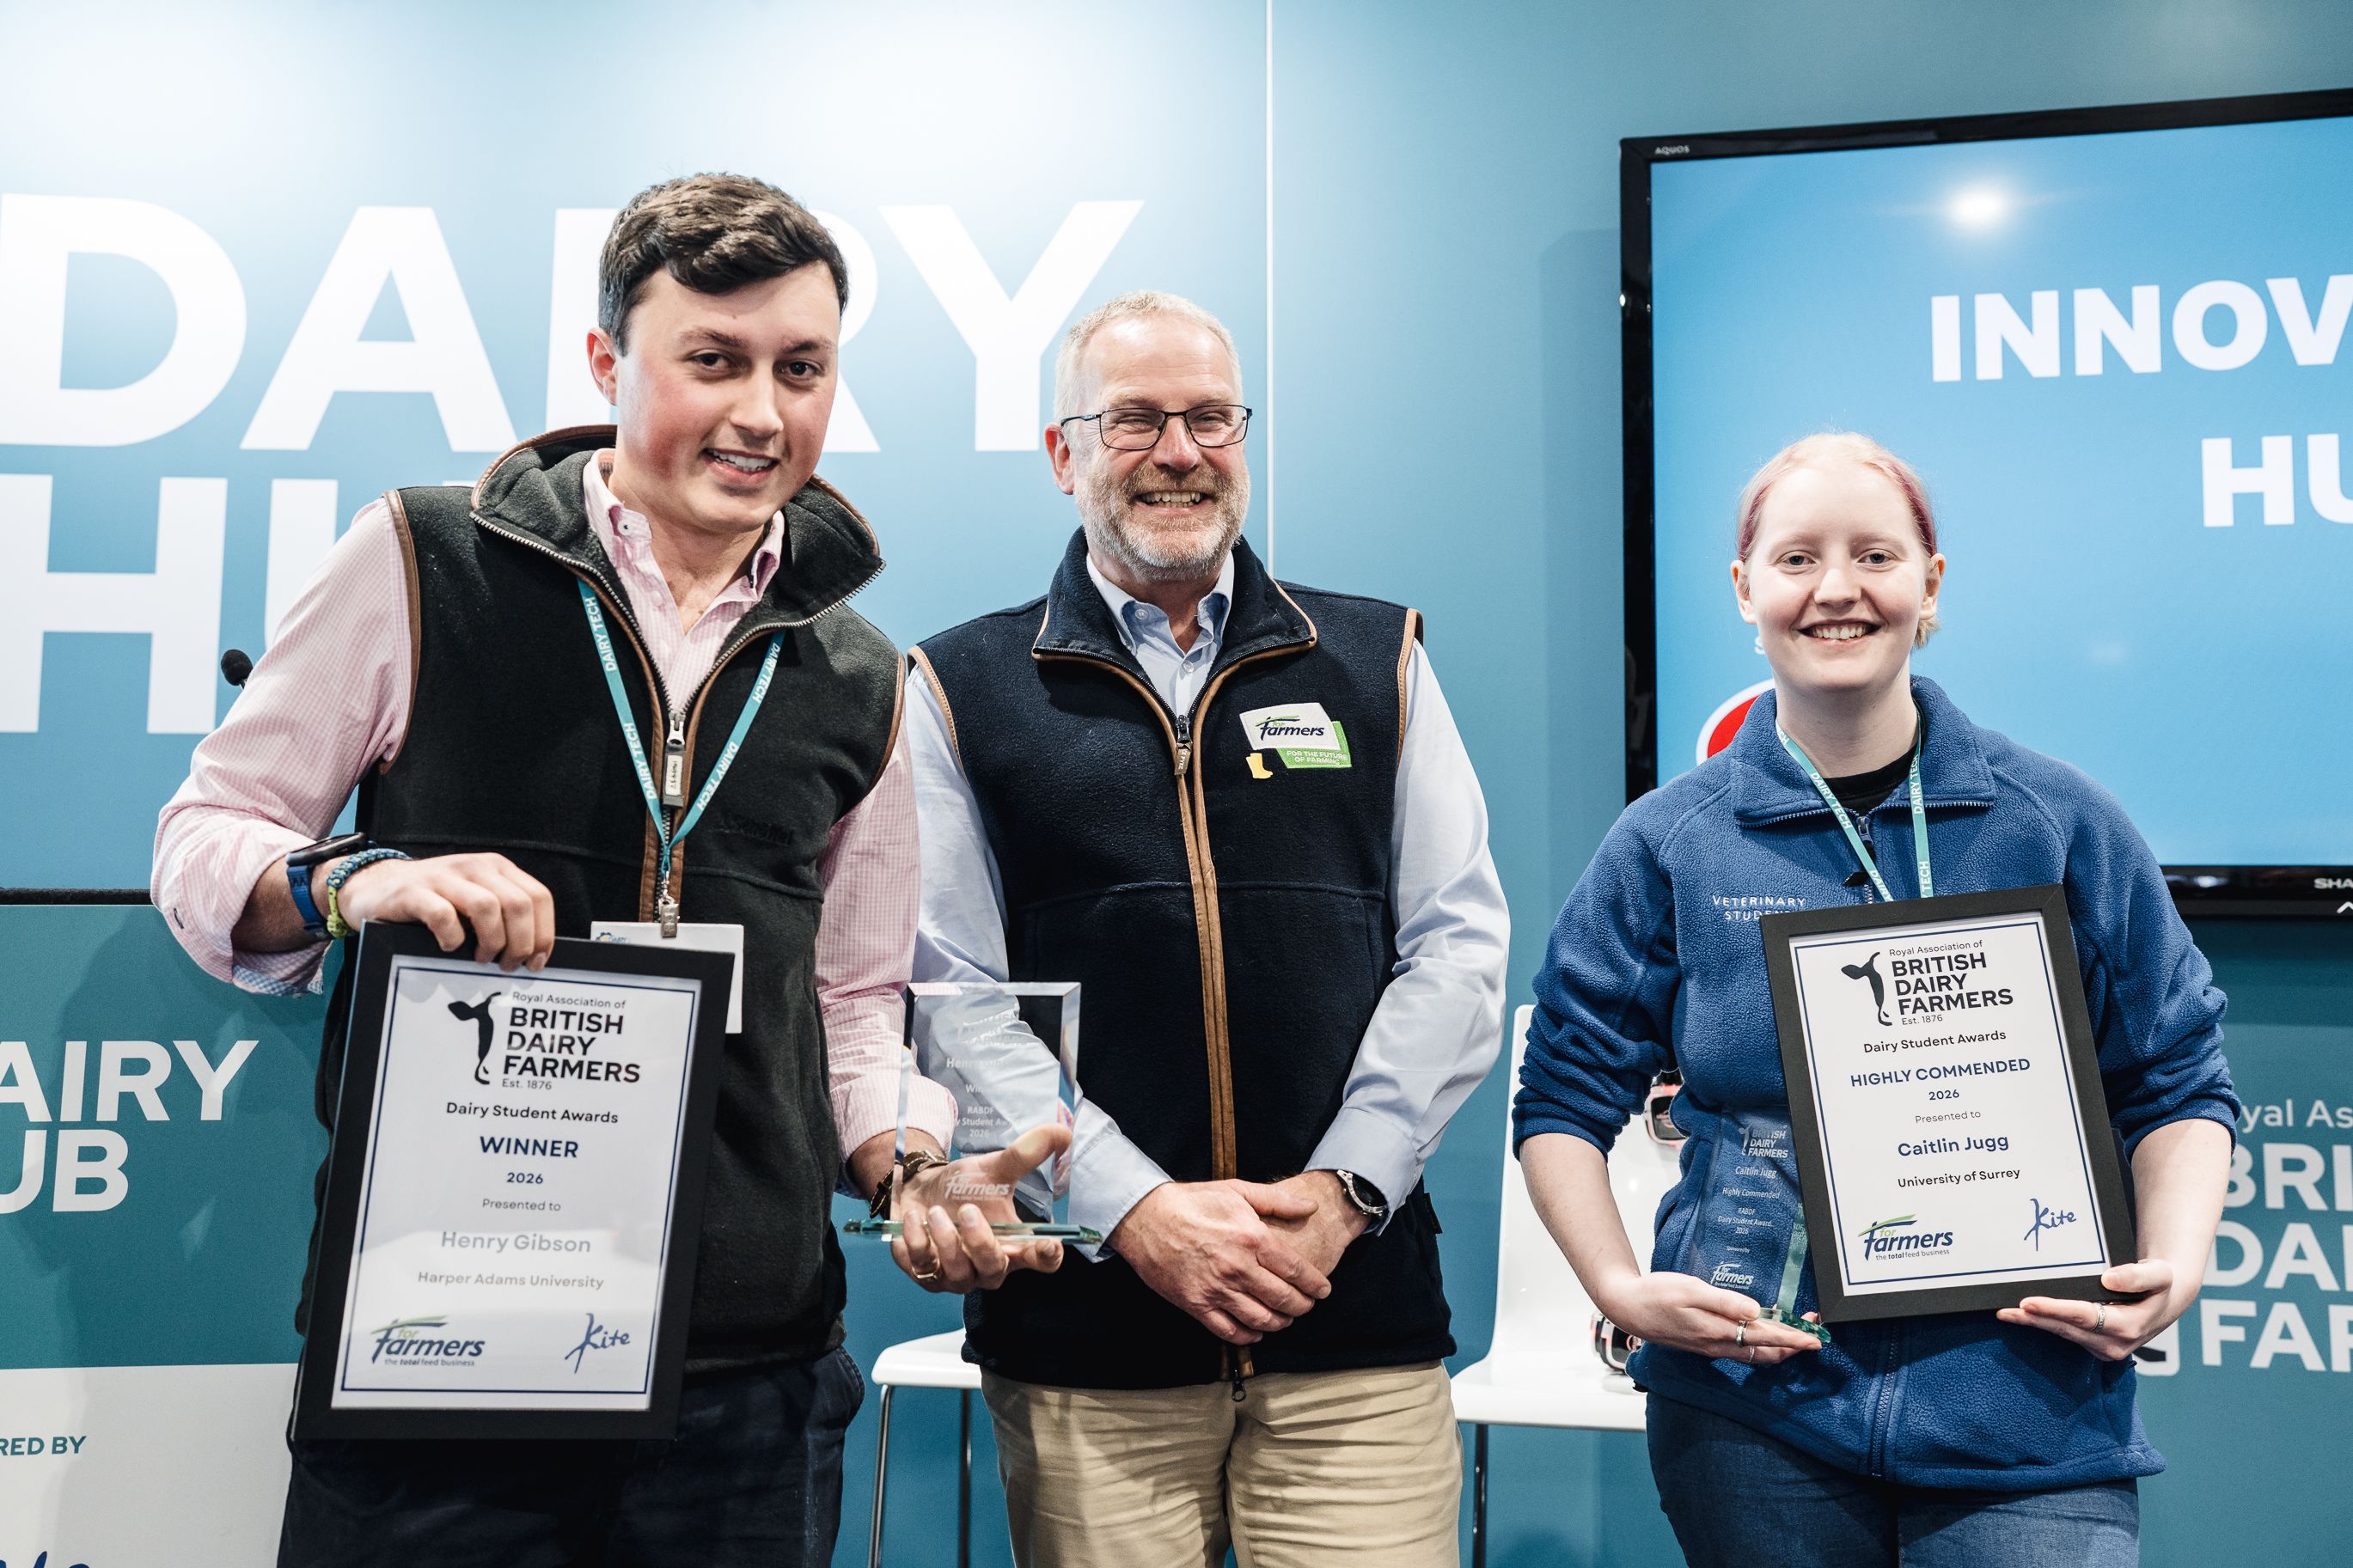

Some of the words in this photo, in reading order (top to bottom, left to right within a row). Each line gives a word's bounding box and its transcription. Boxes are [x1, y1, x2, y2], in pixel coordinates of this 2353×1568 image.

[1654, 145, 1690, 156] AQUOS
[0, 193, 1145, 453] DAIY
[1930, 274, 2353, 383] INNOV
[585, 596, 603, 631] TECH
[596, 631, 618, 672] DAIRY
[761, 642, 781, 677] DAIRY
[752, 673, 771, 704] TECH
[624, 723, 644, 758] TECH
[1777, 730, 1789, 745] CH
[716, 741, 739, 778] DAIRY
[1306, 758, 1340, 766] FARMING
[1909, 754, 1919, 778] TECH
[636, 759, 657, 800] DAIRY
[696, 778, 720, 811] TECH
[1810, 772, 1835, 801] DAIRY
[1830, 801, 1853, 829] TECH
[1911, 779, 1923, 815] DAIRY
[1868, 869, 1894, 902] DAIRY
[1919, 860, 1930, 893] TECH
[1712, 894, 1806, 907] VETERINARY
[1724, 910, 1796, 921] STUD
[1889, 947, 1916, 958] Royal
[1916, 941, 1971, 955] Association
[1973, 939, 1983, 949] of
[1892, 951, 1988, 978] BRITISH
[1895, 973, 1968, 997] DAIRY
[512, 991, 544, 1004] Royal
[546, 994, 611, 1009] Association
[614, 1000, 626, 1010] of
[1898, 988, 2014, 1016] FARMERS
[510, 1006, 624, 1035] BRITISH
[1902, 1017, 1920, 1026] Est.
[1922, 1014, 1943, 1024] 1876
[507, 1031, 597, 1056] DAIRY
[1863, 1040, 1898, 1053] Dairy
[1900, 1035, 1955, 1050] Student
[1958, 1030, 2007, 1045] Awards
[503, 1055, 641, 1083] FARMERS
[1850, 1069, 1911, 1088] HIGHLY
[1915, 1058, 2031, 1081] COMMENDED
[0, 1040, 260, 1122] AIRY
[502, 1077, 523, 1089] Est.
[527, 1079, 553, 1090] 1876
[1928, 1089, 1960, 1101] 2026
[446, 1101, 490, 1118] Dairy
[492, 1105, 557, 1120] Student
[559, 1109, 619, 1124] Awards
[962, 1117, 994, 1126] Student
[967, 1106, 995, 1114] RABDF
[1915, 1110, 1968, 1124] Presented
[1970, 1110, 1982, 1119] to
[2236, 1099, 2294, 1133] yal
[480, 1135, 579, 1158] WINNER
[1748, 1147, 1788, 1158] FARMERS
[1750, 1138, 1776, 1149] DAIRY
[1898, 1138, 1960, 1156] Caitlin
[1964, 1136, 2009, 1152] Jugg
[506, 1171, 544, 1185] 2026
[1735, 1166, 1758, 1176] Caitlin
[1759, 1168, 1777, 1179] Jugg
[1898, 1174, 1961, 1187] University
[1964, 1171, 1977, 1182] of
[1978, 1168, 2021, 1181] Surrey
[1722, 1187, 1741, 1197] Highly
[1741, 1189, 1781, 1199] Commended
[482, 1199, 547, 1211] Presented
[548, 1201, 562, 1211] to
[1738, 1207, 1756, 1216] RABDF
[1718, 1215, 1733, 1224] Dairy
[1733, 1217, 1754, 1225] Student
[2024, 1198, 2077, 1252] Kite
[441, 1230, 510, 1254] Henry
[514, 1233, 591, 1253] Gibson
[1864, 1221, 1953, 1260] farmers
[1879, 1228, 1897, 1238] for
[1904, 1250, 1920, 1259] feed
[1921, 1248, 1950, 1257] business
[418, 1271, 472, 1285] Harper
[474, 1273, 526, 1286] Adams
[529, 1275, 604, 1290] University
[371, 1318, 486, 1364] farmers
[398, 1328, 419, 1339] for
[564, 1312, 631, 1375] Kite
[400, 1358, 420, 1366] total
[421, 1358, 438, 1366] feed
[441, 1358, 475, 1366] business
[52, 1436, 88, 1455] BY
